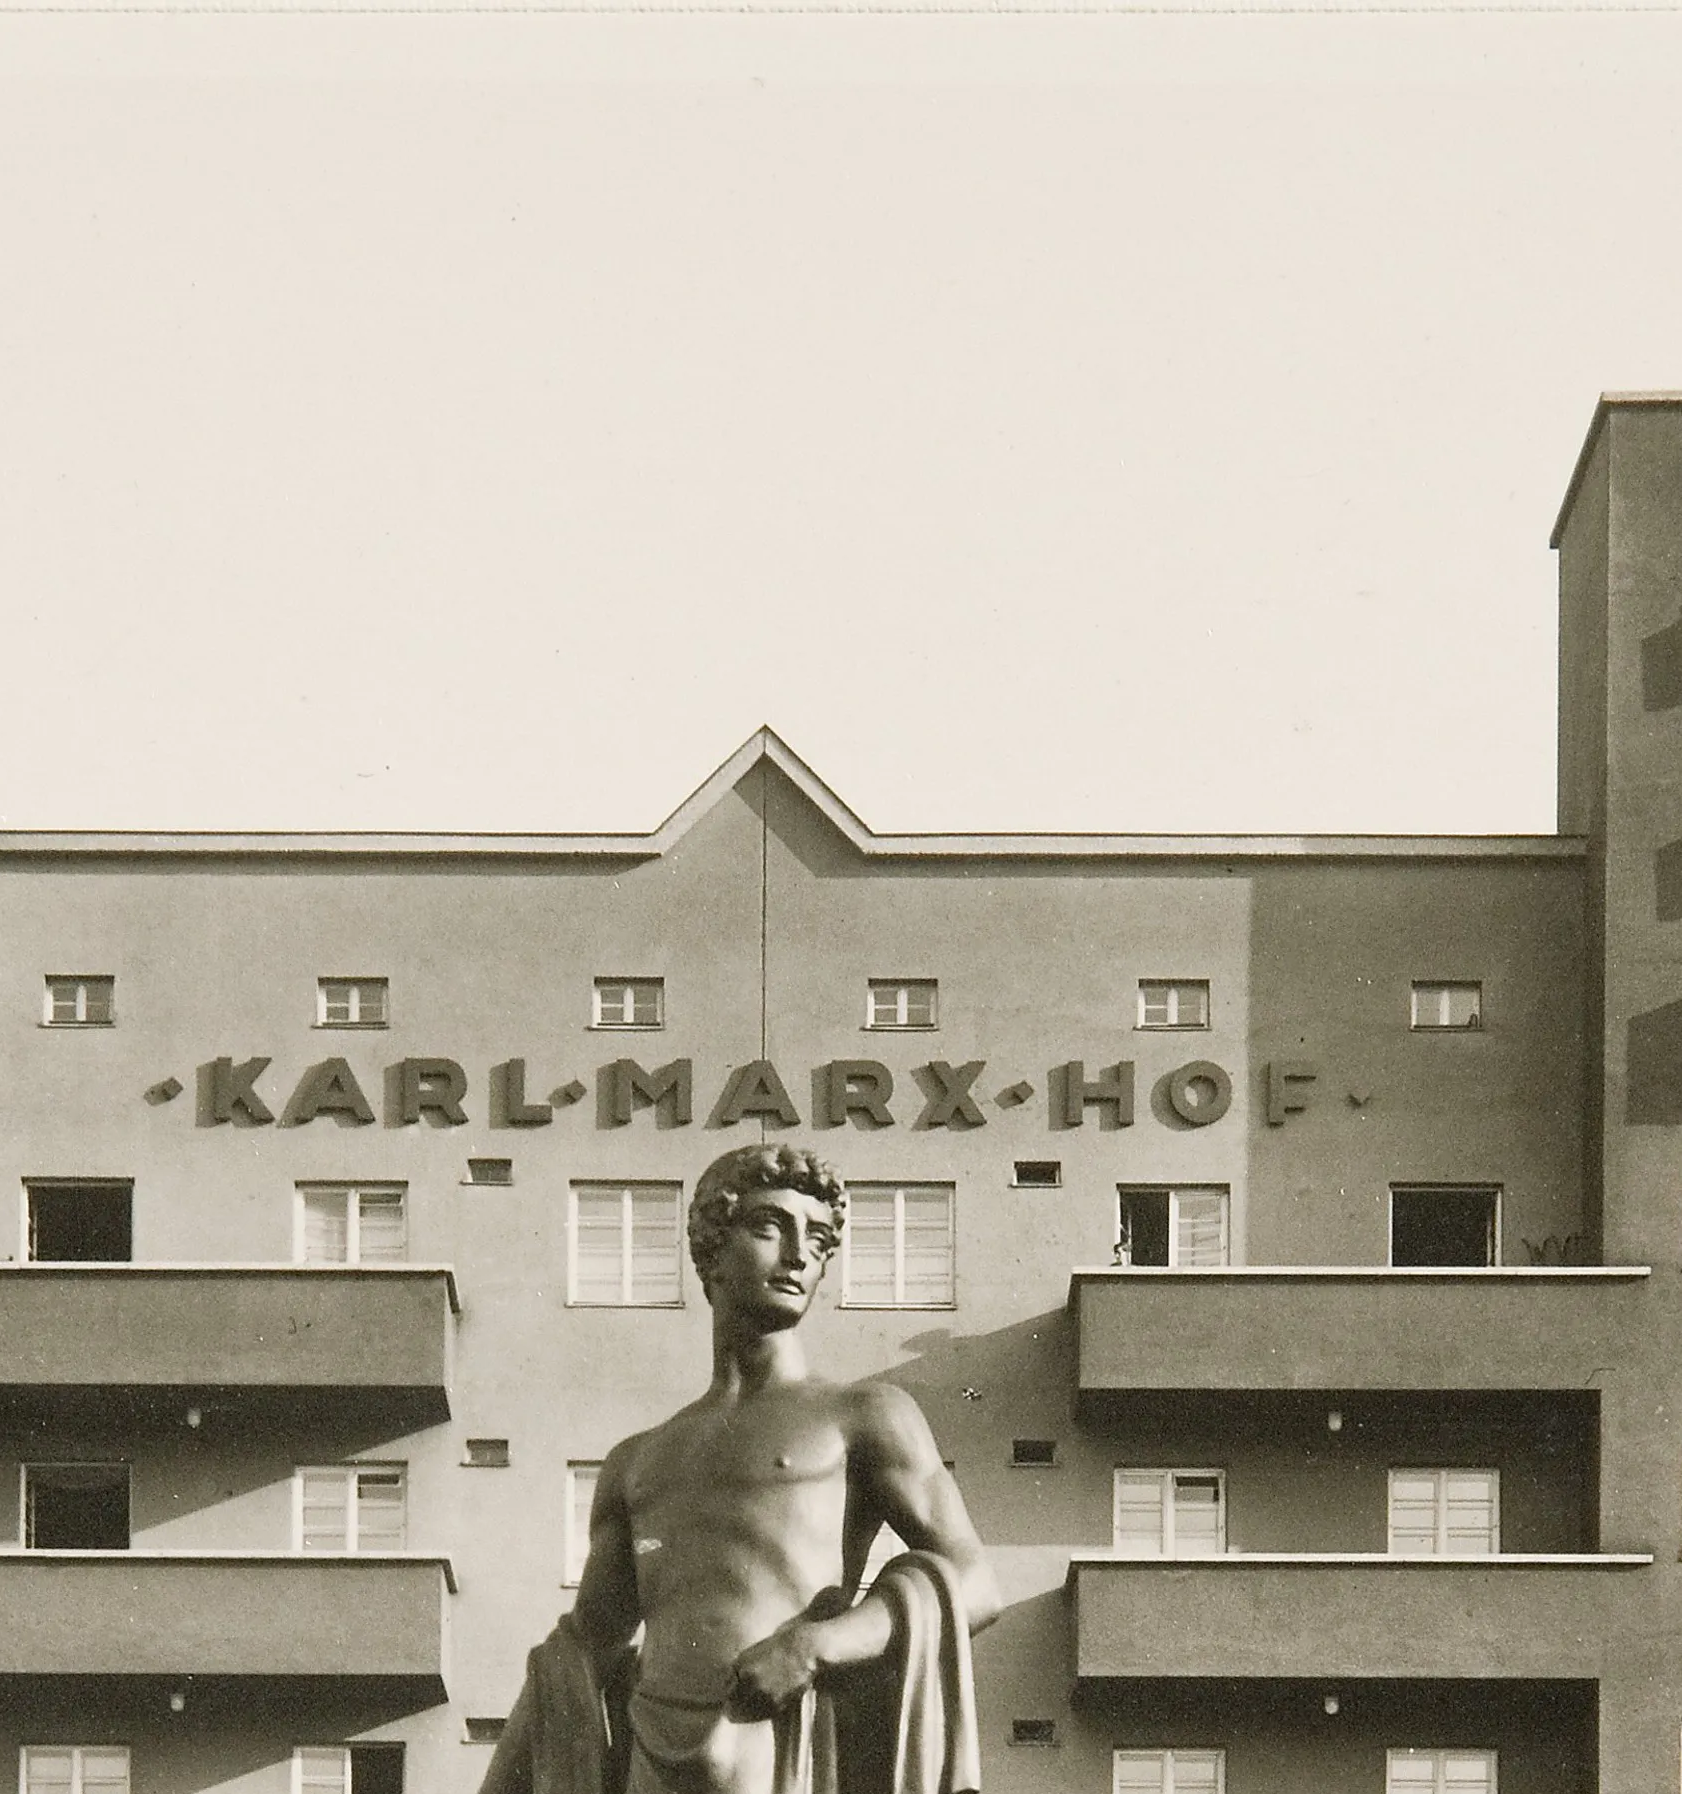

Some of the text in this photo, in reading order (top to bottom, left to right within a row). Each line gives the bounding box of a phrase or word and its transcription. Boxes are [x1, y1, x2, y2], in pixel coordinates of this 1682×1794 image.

[200, 1055, 1318, 1130] KARL MARX HOF
